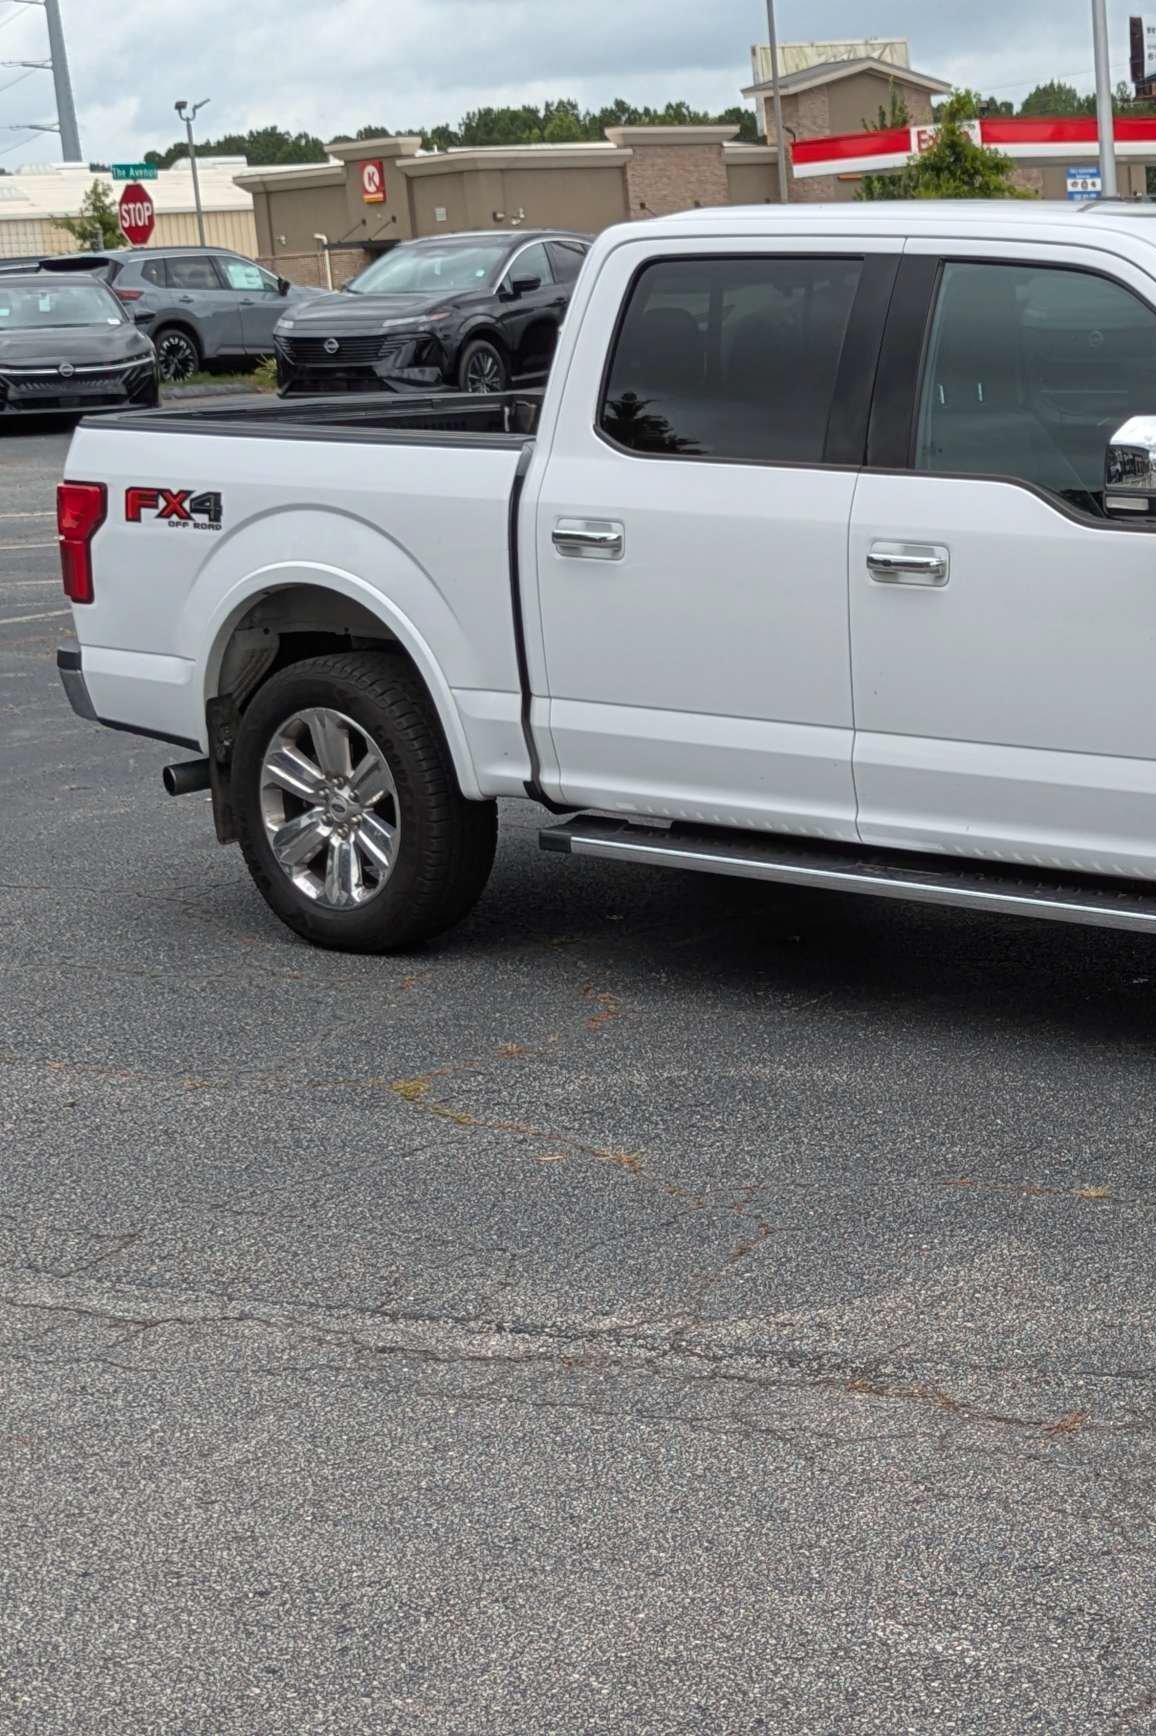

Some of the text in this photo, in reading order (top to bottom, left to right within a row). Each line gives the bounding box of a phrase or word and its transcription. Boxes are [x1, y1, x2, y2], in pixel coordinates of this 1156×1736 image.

[112, 167, 126, 178] The
[121, 202, 152, 228] STOP
[125, 486, 223, 523] FX4
[168, 520, 223, 531] OFF ROAD
